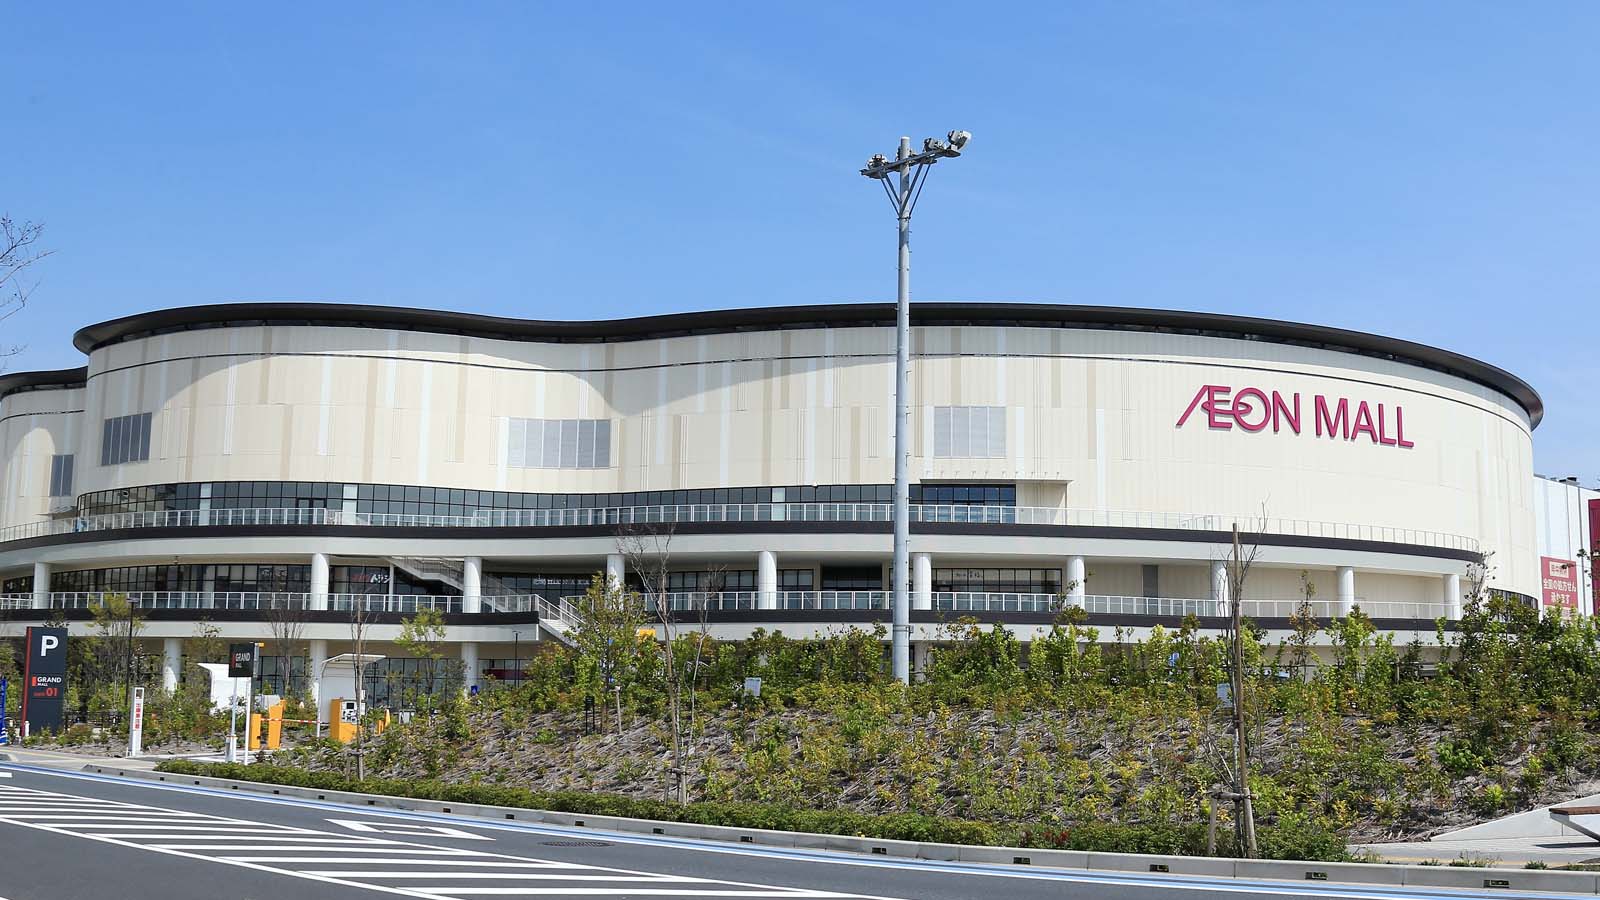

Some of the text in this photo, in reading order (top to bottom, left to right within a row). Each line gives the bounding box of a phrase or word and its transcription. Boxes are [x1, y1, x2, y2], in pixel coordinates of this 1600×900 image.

[1314, 394, 1415, 448] MALL
[41, 635, 59, 657] P
[235, 652, 251, 662] GRAND
[46, 687, 58, 697] 01
